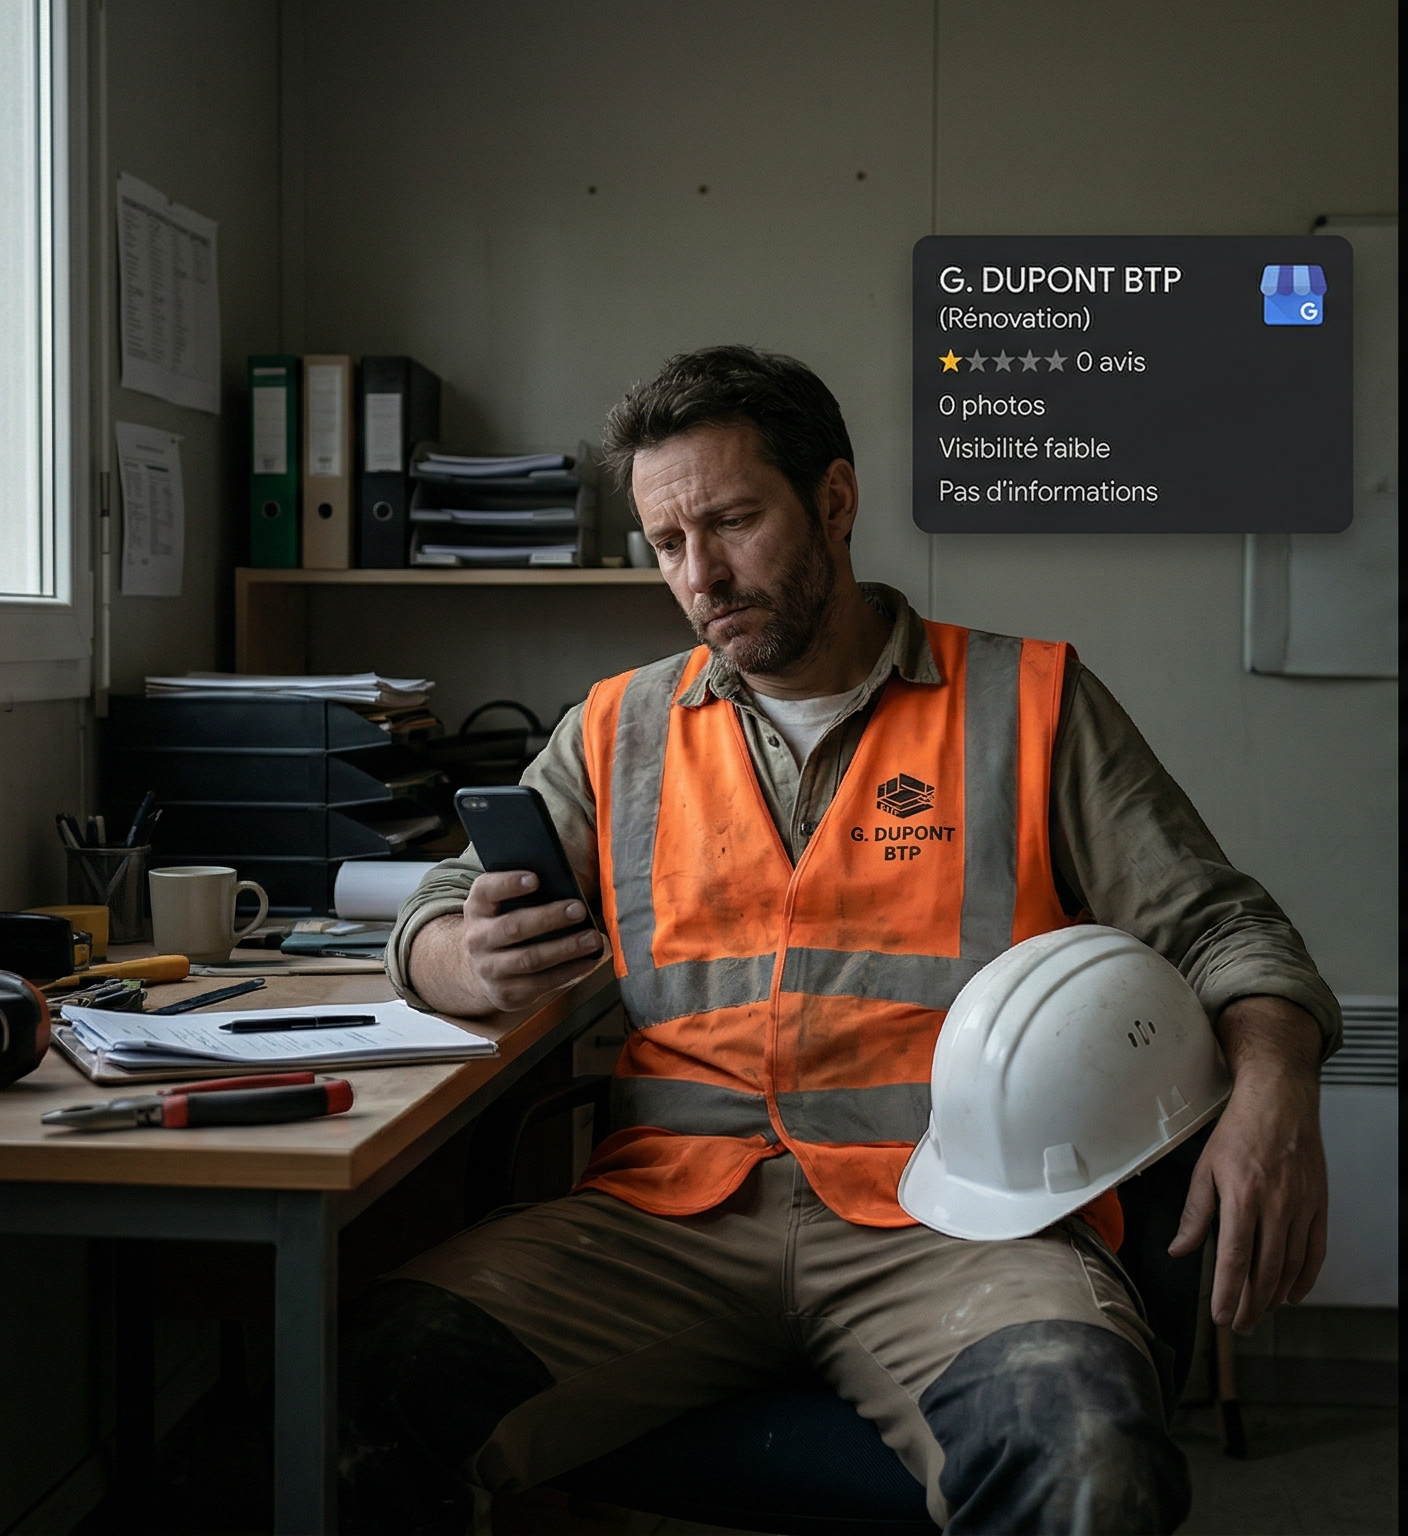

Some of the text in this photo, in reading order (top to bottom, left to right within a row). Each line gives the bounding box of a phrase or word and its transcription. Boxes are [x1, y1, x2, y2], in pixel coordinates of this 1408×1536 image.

[850, 825, 956, 842] G. DUPONT
[884, 845, 922, 861] BTP
